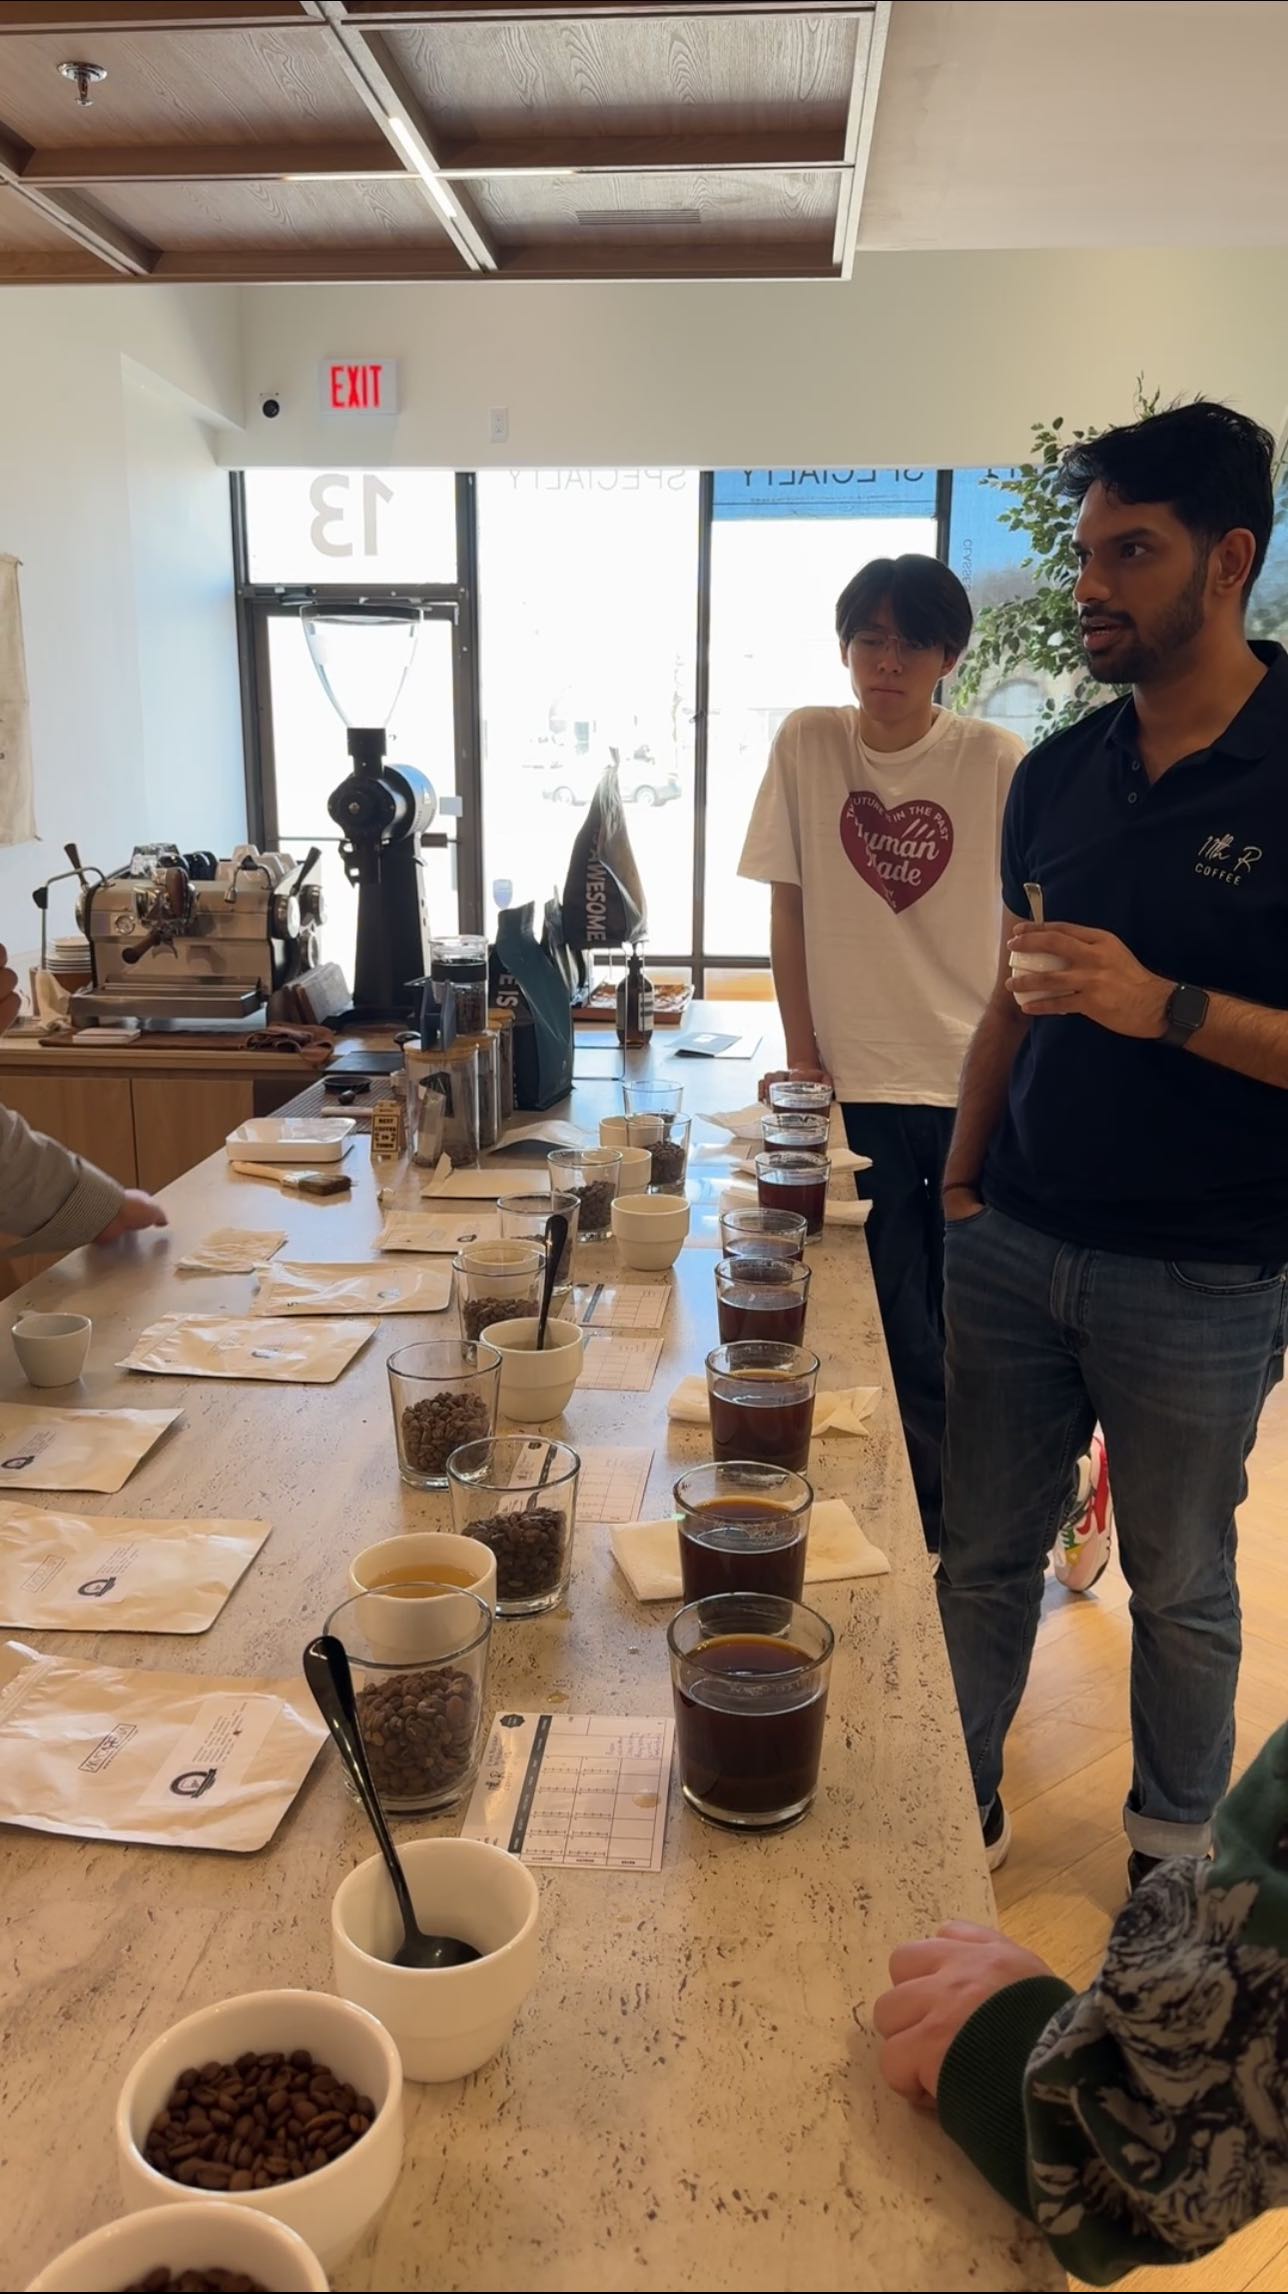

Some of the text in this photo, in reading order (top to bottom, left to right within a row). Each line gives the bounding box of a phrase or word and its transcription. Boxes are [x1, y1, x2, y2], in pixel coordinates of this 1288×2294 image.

[331, 365, 383, 408] EXIT
[853, 796, 885, 816] UTURE
[909, 806, 931, 817] THE
[934, 812, 949, 841] PAST
[1233, 846, 1263, 873] R
[1195, 863, 1242, 886] COFFEE
[496, 990, 519, 1008] IS
